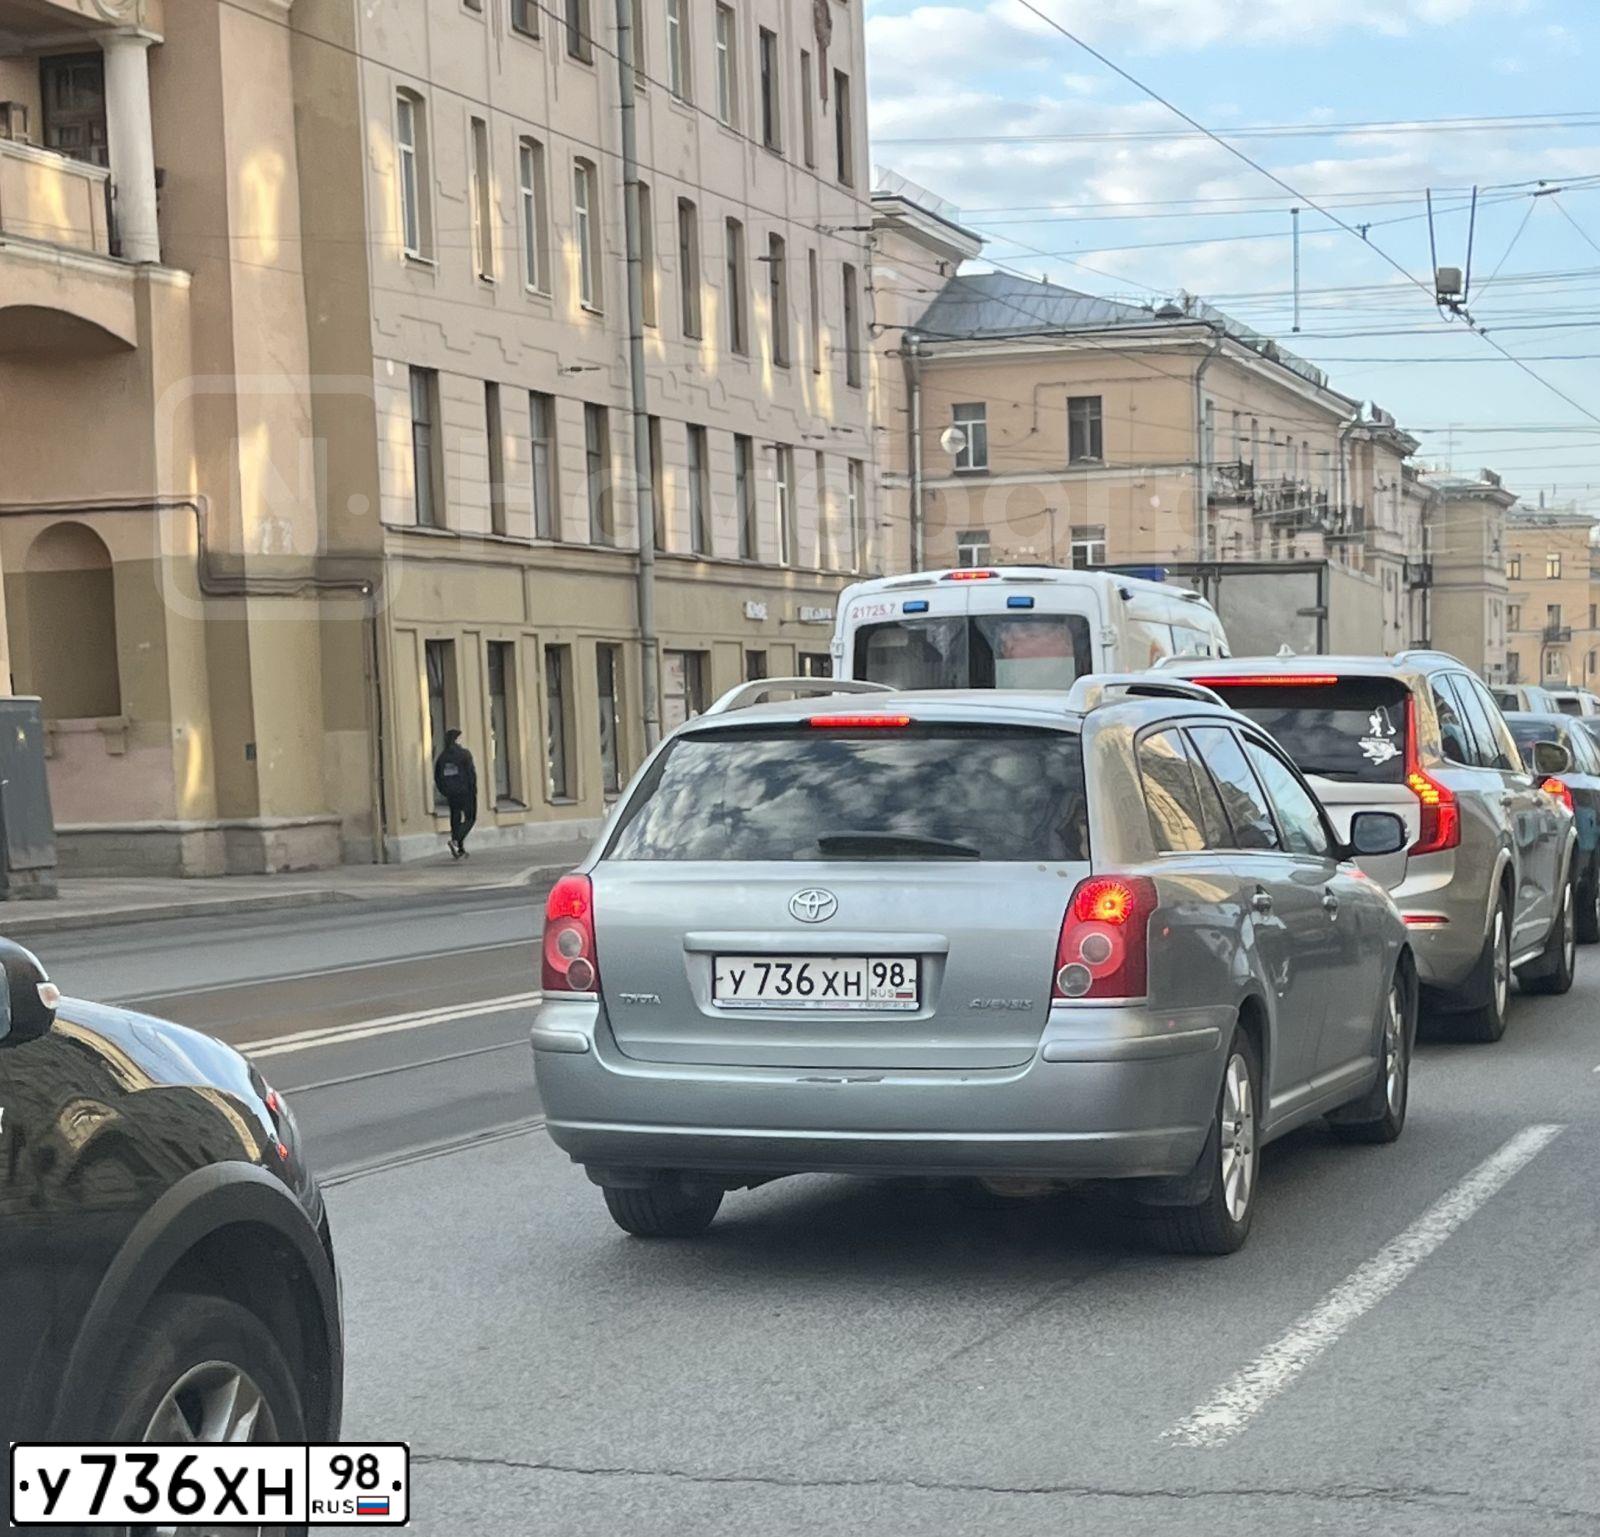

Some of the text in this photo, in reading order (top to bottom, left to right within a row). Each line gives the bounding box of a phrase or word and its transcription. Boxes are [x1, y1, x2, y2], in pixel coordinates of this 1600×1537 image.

[729, 962, 905, 996] У736ХН 98
[870, 988, 895, 998] RUS
